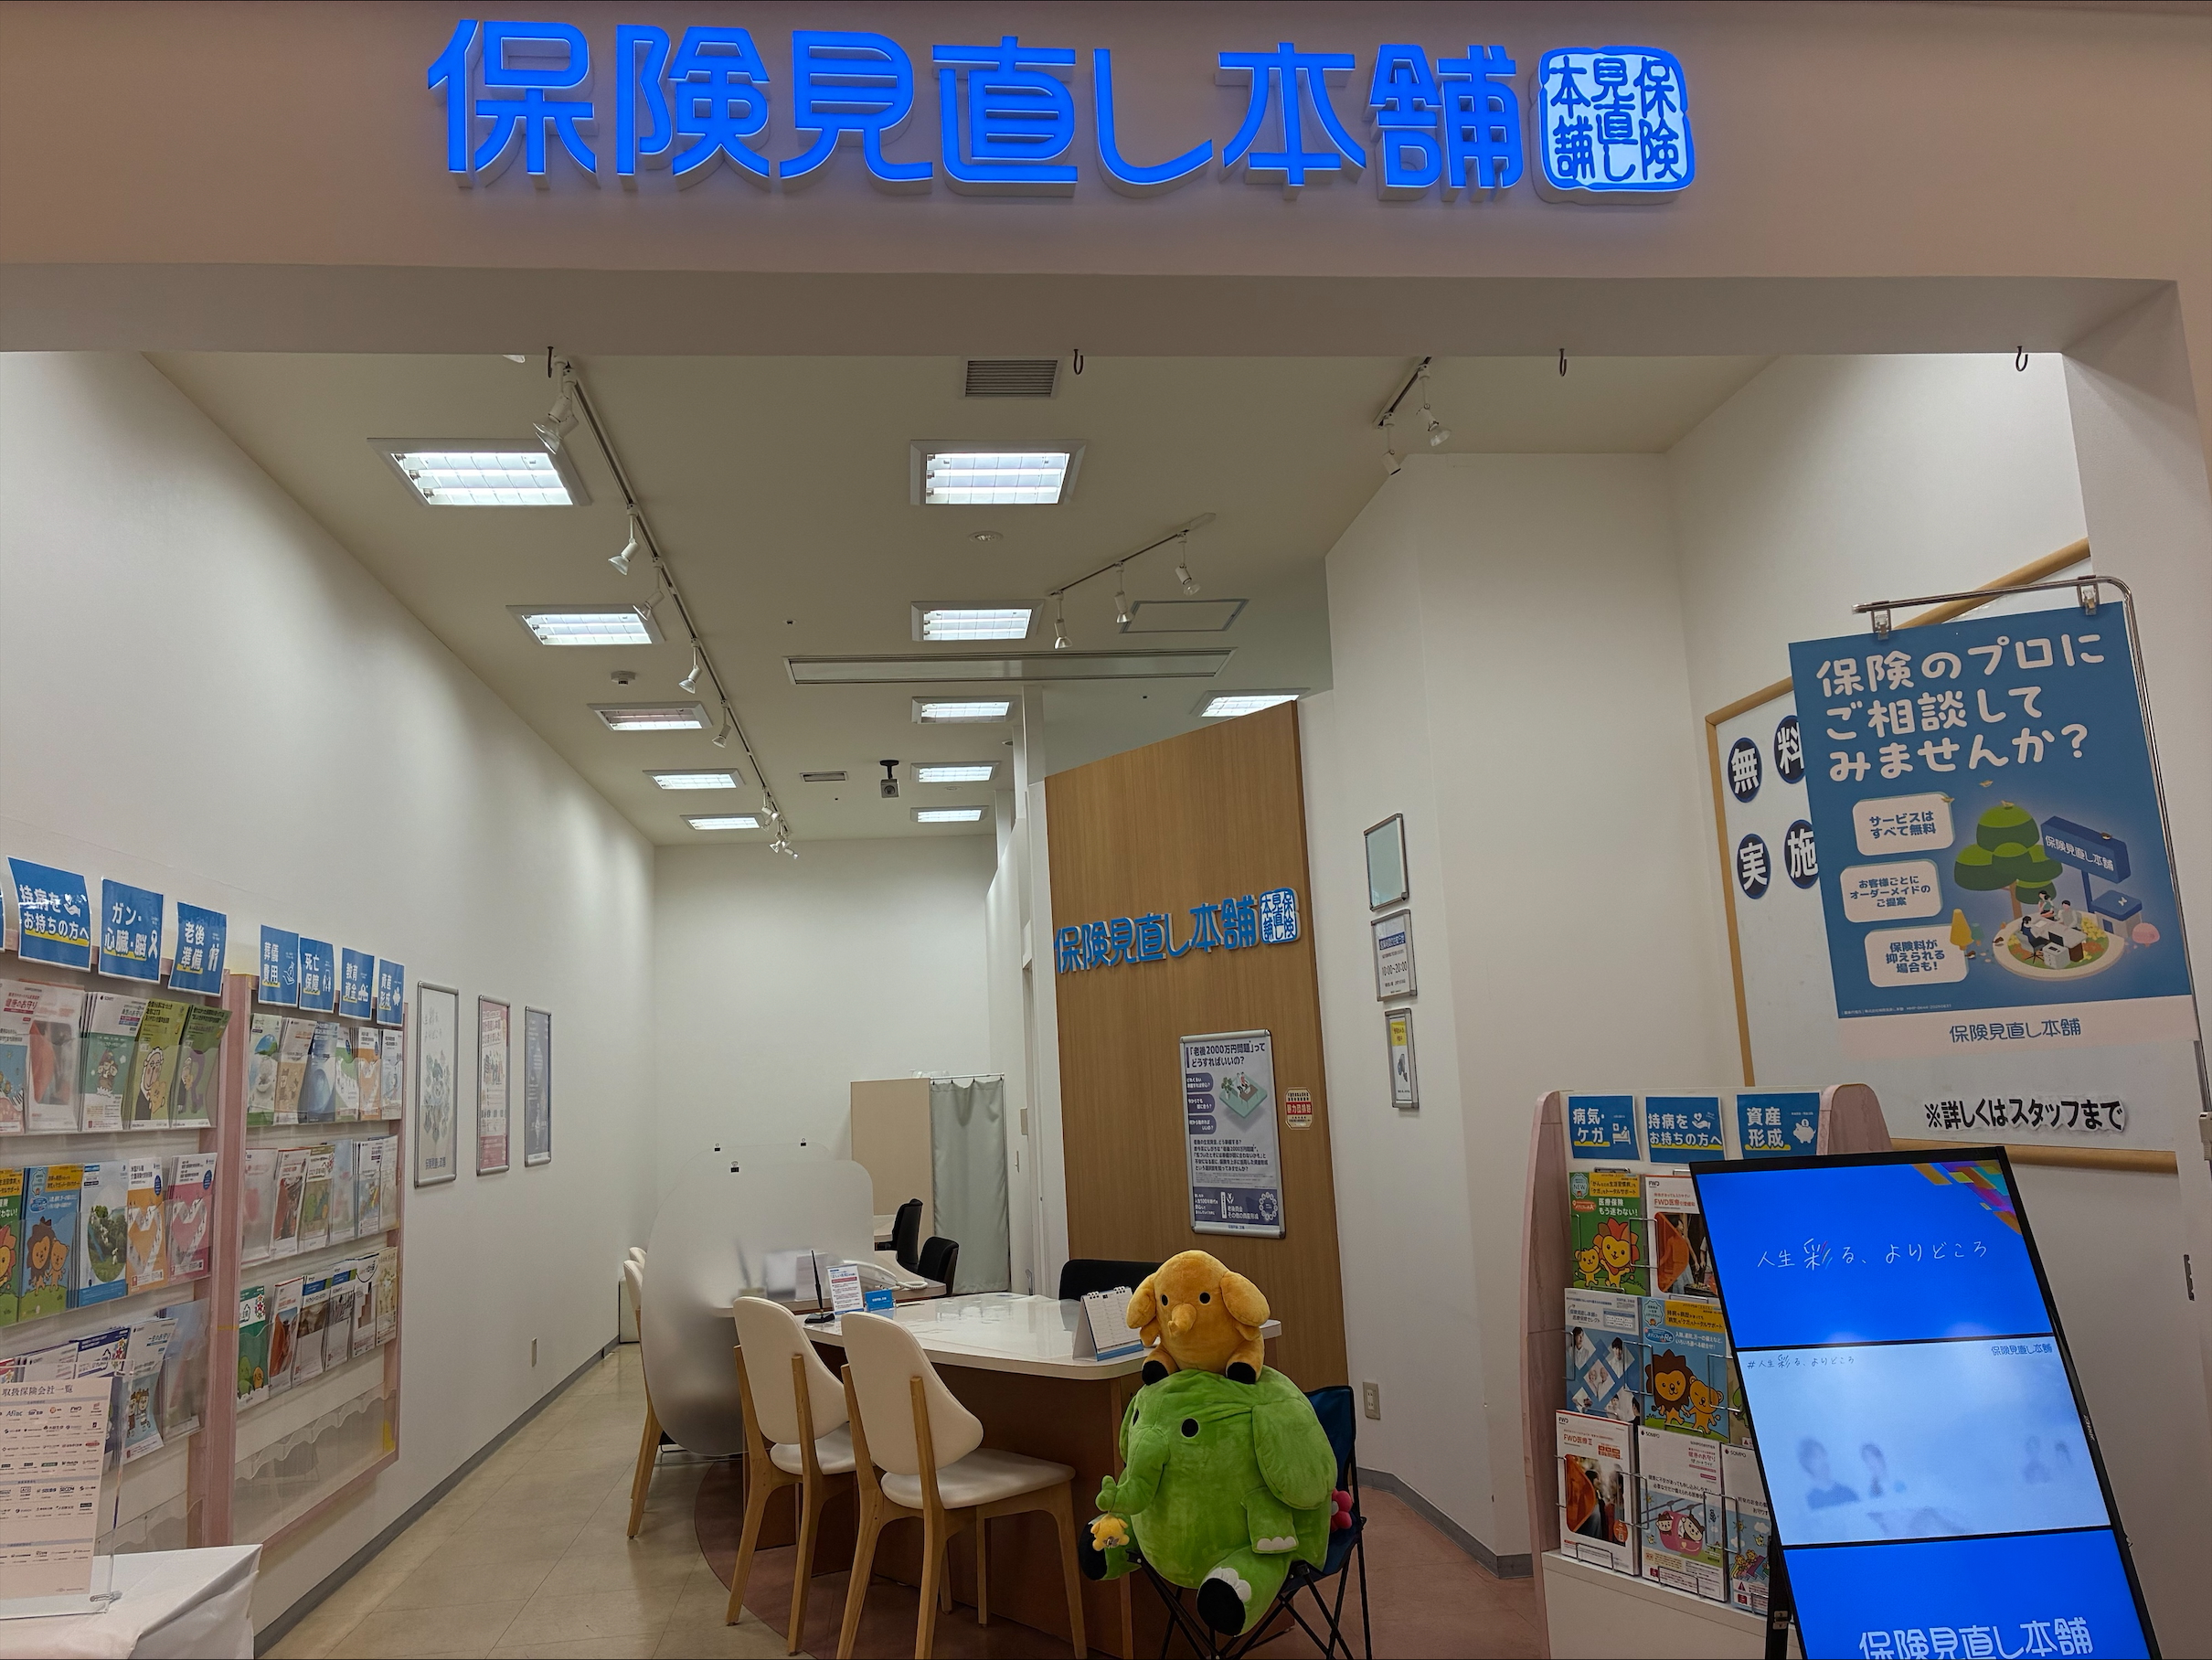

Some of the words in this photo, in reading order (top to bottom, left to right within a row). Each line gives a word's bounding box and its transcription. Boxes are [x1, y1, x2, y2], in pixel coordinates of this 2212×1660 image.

[428, 19, 1524, 186] 保険見直し本舗
[1549, 55, 1596, 179] 本舗
[1590, 58, 1638, 181] 見直し
[1633, 57, 1682, 180] 保険
[1816, 633, 2104, 697] 保険のプロに
[1825, 686, 2044, 740] ご相談して
[1828, 723, 2089, 782] みませんか?
[1869, 811, 1934, 826] サービスは
[1870, 823, 1936, 839] すべて無料
[2045, 835, 2114, 872] 保険見直し本舗
[1849, 884, 1931, 900] オーダーメイドの
[1858, 876, 1920, 889] お客様ごとに
[18, 884, 61, 913] 持病を
[1876, 897, 1907, 908] ご提案
[24, 911, 90, 940] お持ちの方へ
[185, 921, 204, 946] 老後
[1054, 896, 1258, 973] 保険見直し本舗
[104, 927, 147, 956] 心臓・脳
[1890, 940, 1938, 952] 保険料が
[181, 947, 203, 970] 準備
[304, 952, 319, 972] 死亡
[1886, 950, 1945, 963] 抑えられる
[263, 963, 279, 984] 費用
[346, 962, 357, 981] 教育
[1897, 961, 1938, 974] 場合も!
[304, 974, 319, 992] 保障
[1949, 1018, 2081, 1043] 保険見直し本舗
[1190, 1042, 1265, 1056] 「老後2000万円問題」って
[1192, 1057, 1244, 1068] どうすればいいの?
[1648, 1112, 1688, 1130] 持病を
[1746, 1106, 1781, 1126] 資産
[1924, 1098, 2122, 1131] ※詳しくはスタッフまで
[1577, 1127, 1604, 1144] ケガ
[1649, 1132, 1723, 1146] お持ちの方へ
[1748, 1128, 1784, 1148] 形成
[1598, 1197, 1623, 1206] 医療保険
[1599, 1208, 1638, 1216] もう迷わない!
[1757, 1238, 1989, 1272] 人生彩る、よりどころ
[1991, 1344, 2053, 1357] 保険見直し本舗
[2, 1385, 73, 1397] 取扱保険会社一覧
[1859, 1617, 2094, 1660] 保険見直し本舗
